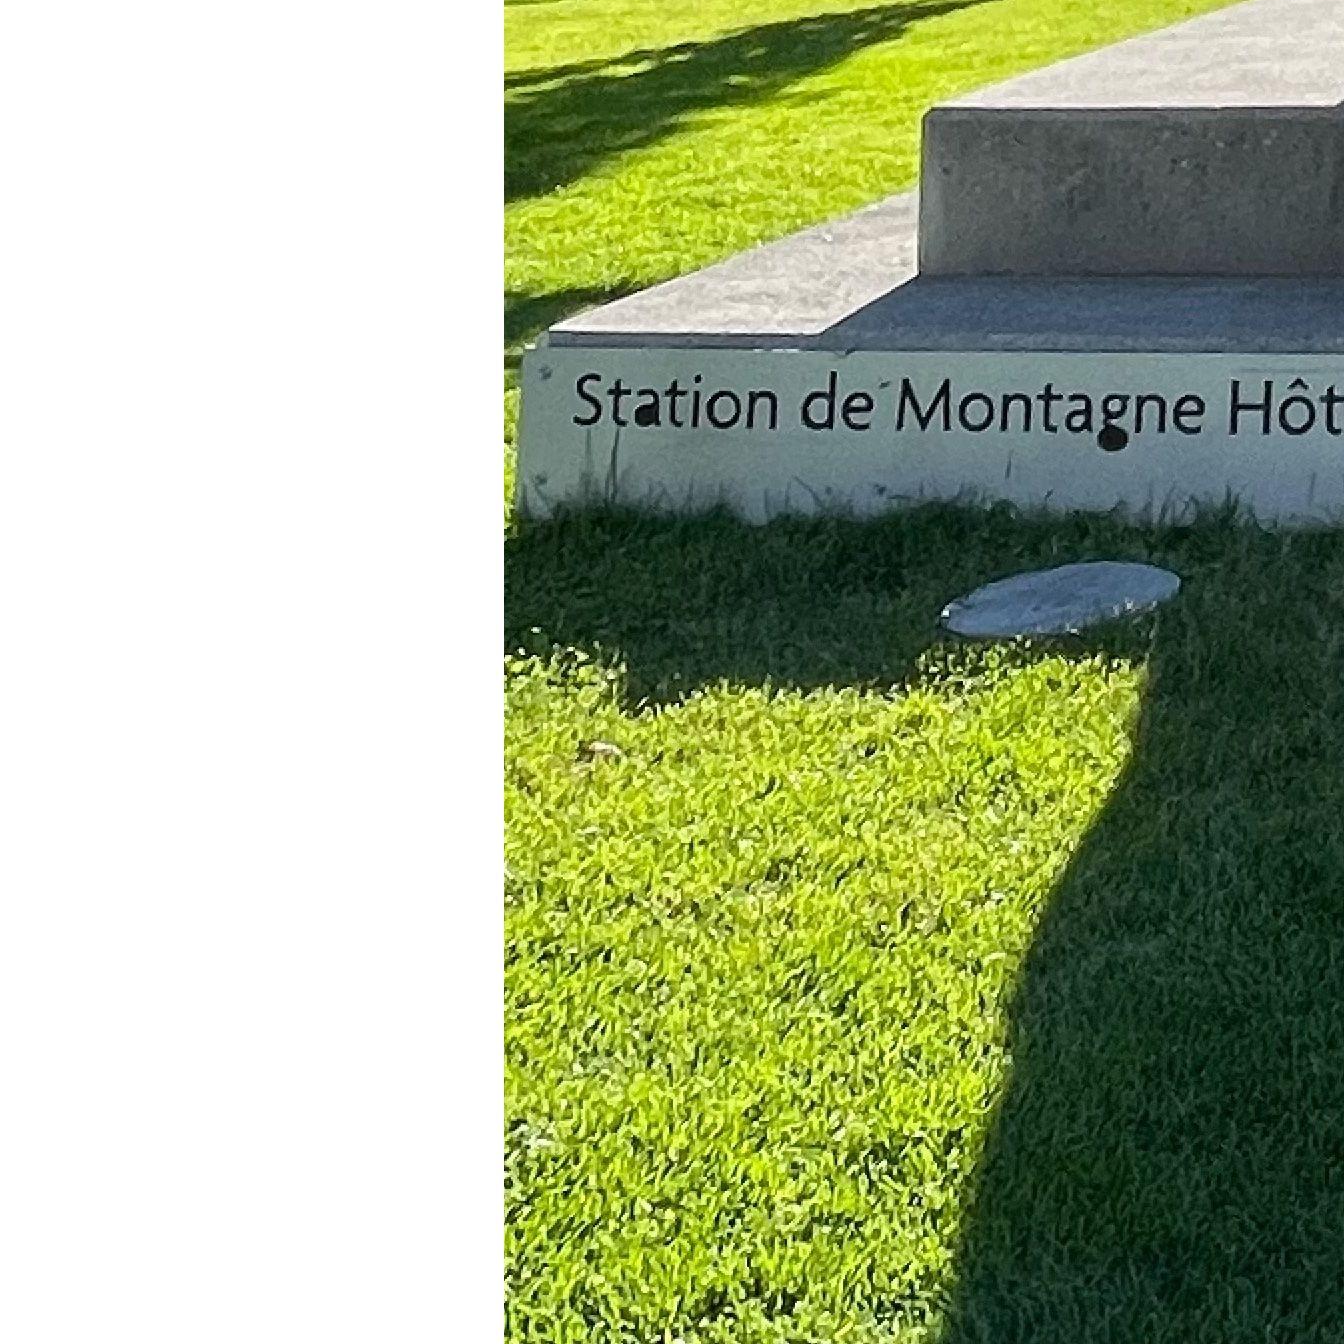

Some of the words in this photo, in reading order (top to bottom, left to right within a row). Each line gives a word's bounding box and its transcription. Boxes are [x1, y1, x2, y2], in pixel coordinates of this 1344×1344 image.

[572, 372, 779, 430] Station
[801, 370, 875, 431] de
[896, 378, 1207, 452] Montagne
